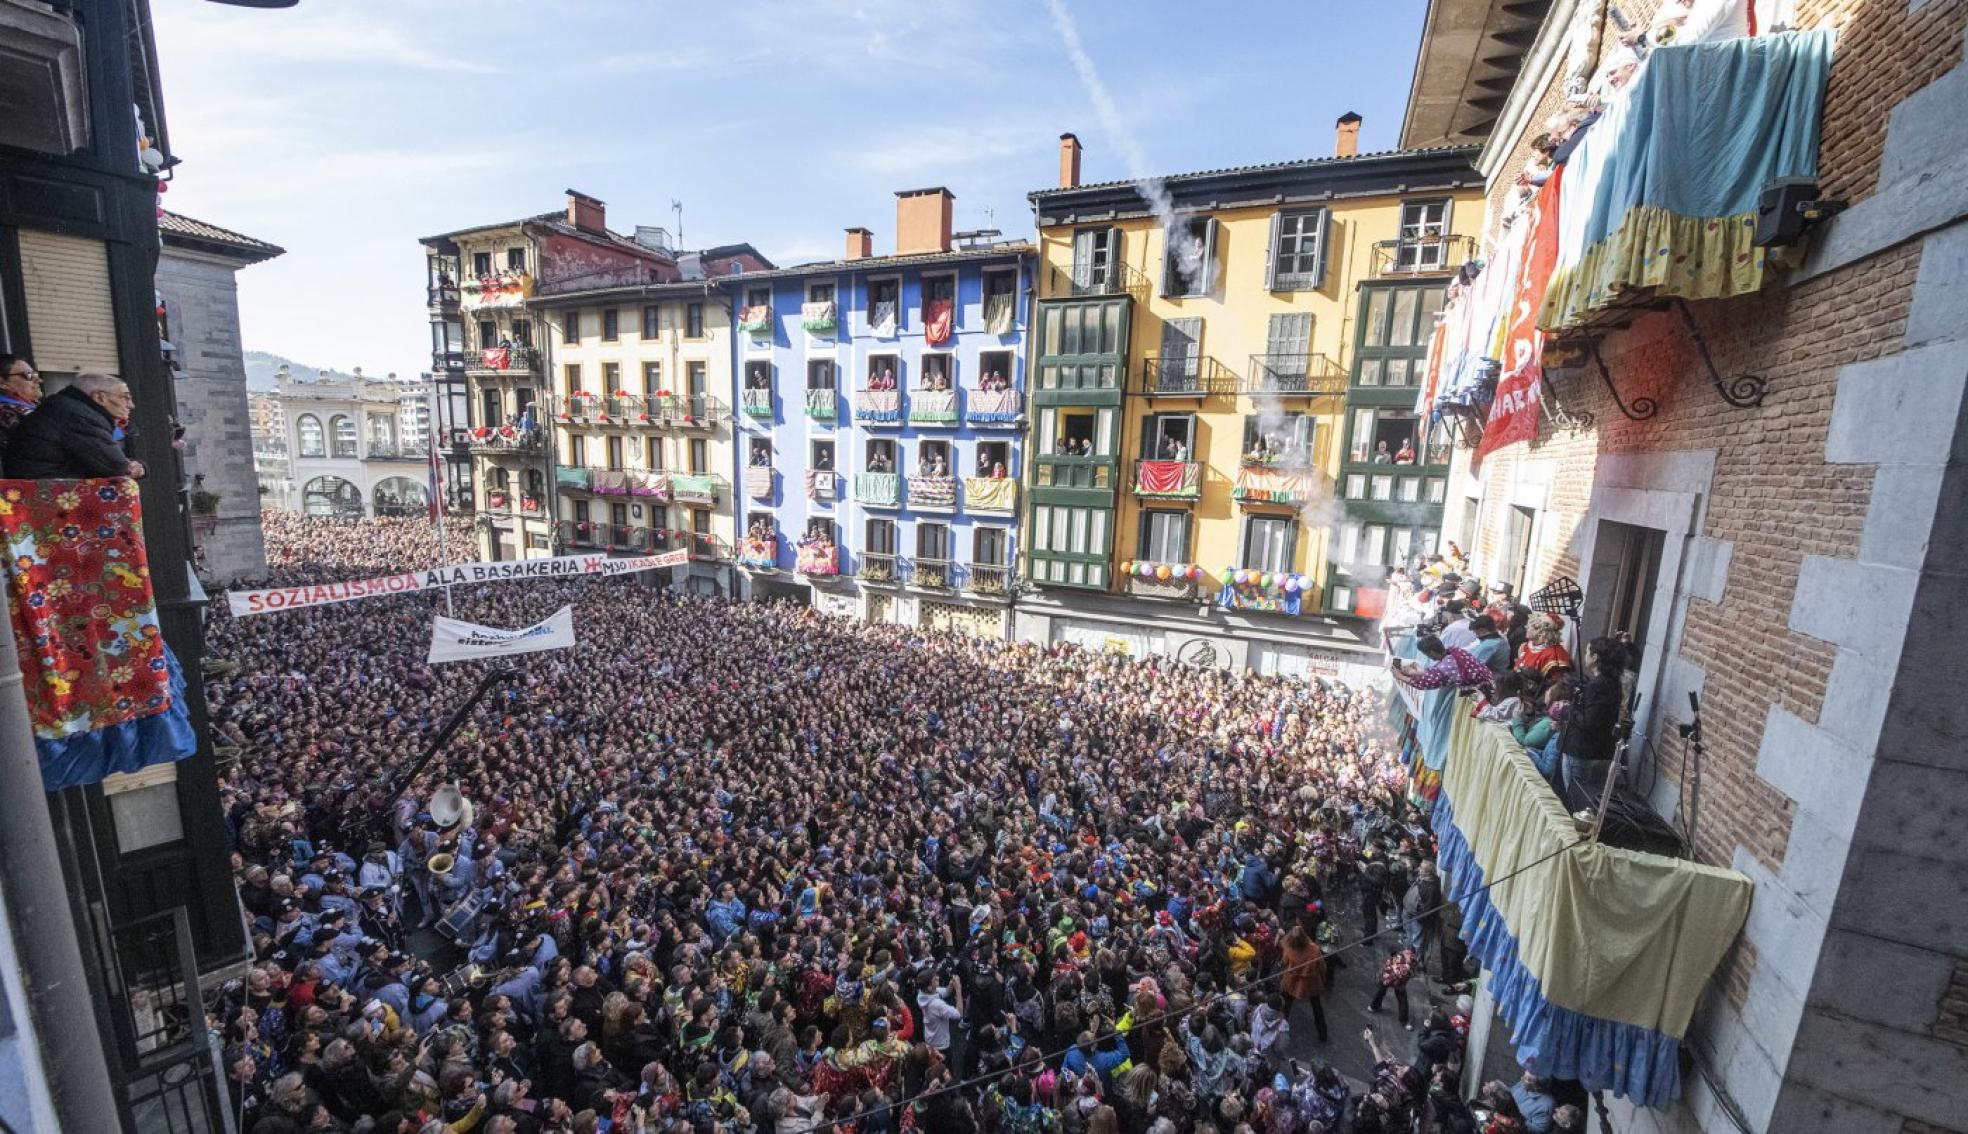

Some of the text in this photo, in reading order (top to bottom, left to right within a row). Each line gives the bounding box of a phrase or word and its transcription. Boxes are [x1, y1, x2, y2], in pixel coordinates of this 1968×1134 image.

[248, 560, 579, 611] SOZIALISMOA ALA BASAKERIA
